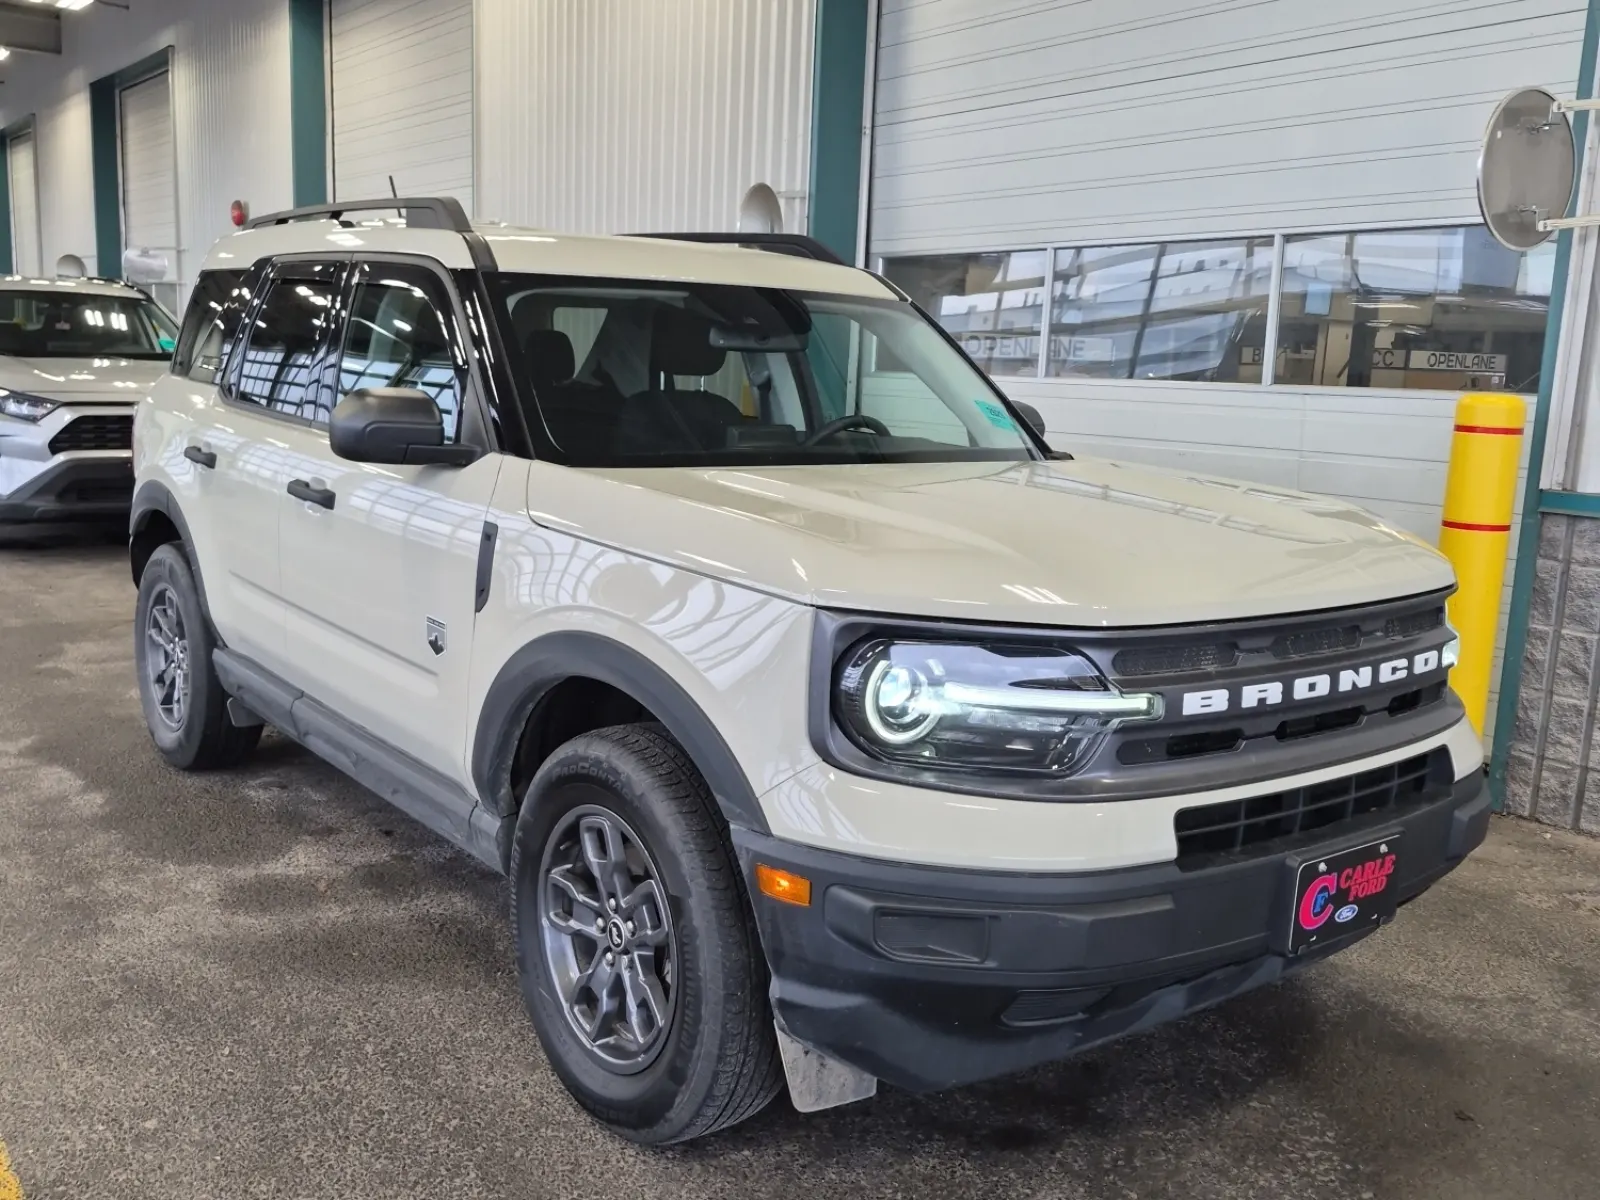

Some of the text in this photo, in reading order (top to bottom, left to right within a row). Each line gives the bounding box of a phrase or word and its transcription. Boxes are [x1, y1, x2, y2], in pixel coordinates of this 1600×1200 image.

[1427, 352, 1497, 370] OPENLANE
[1182, 650, 1439, 716] BRONCO
[1340, 854, 1396, 889] CARLE
[1347, 876, 1388, 902] FORD
